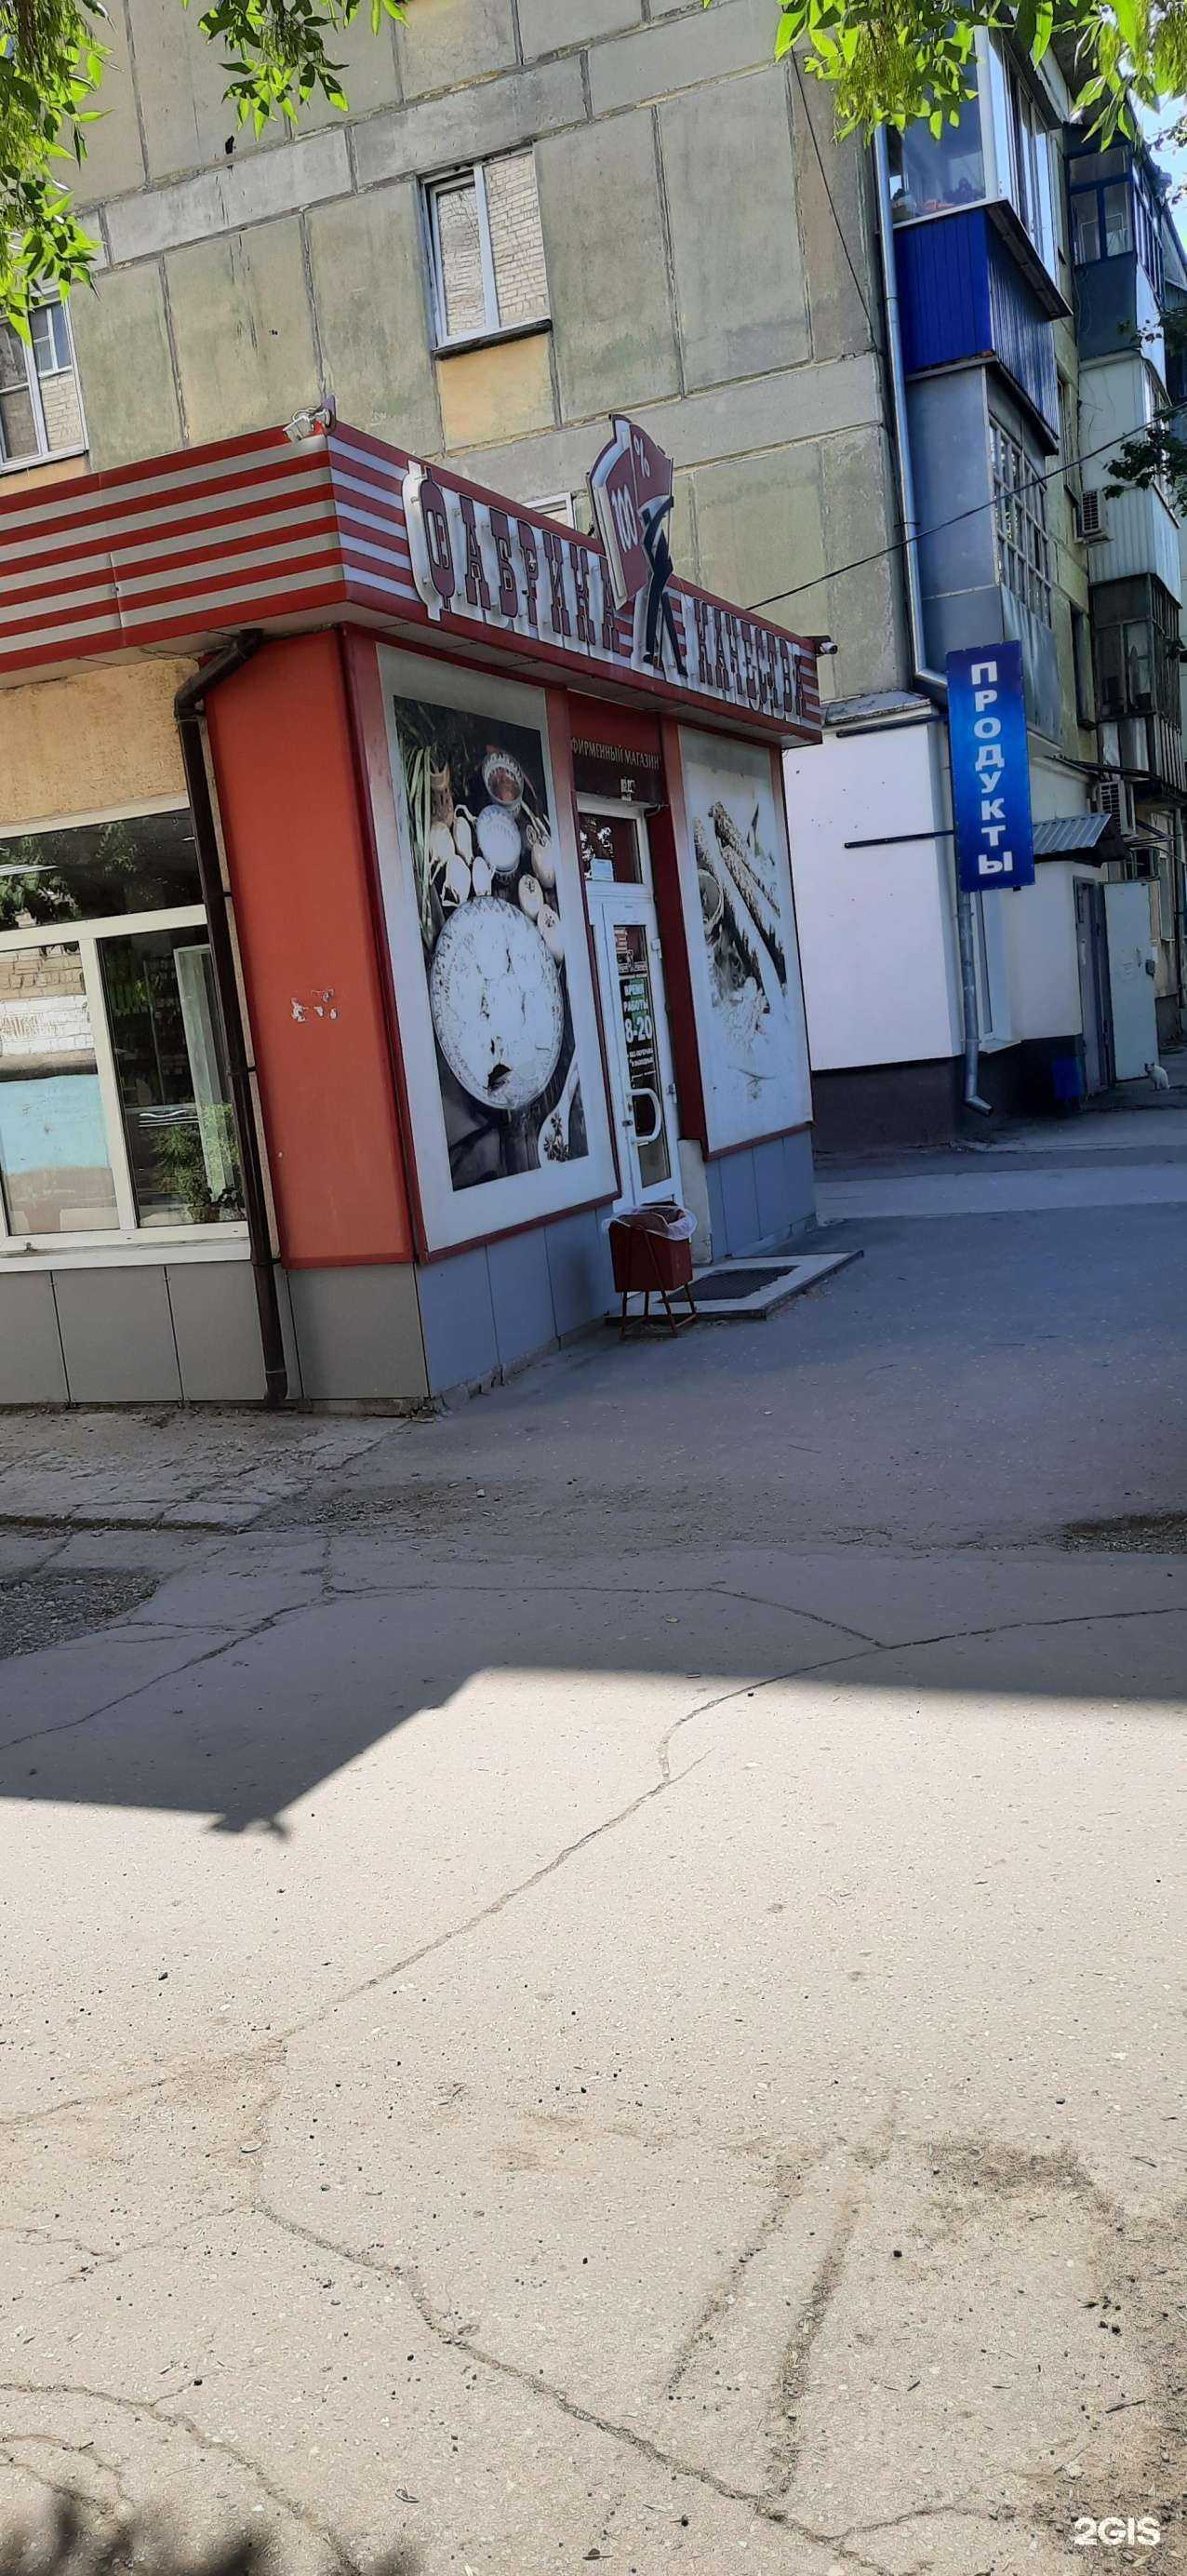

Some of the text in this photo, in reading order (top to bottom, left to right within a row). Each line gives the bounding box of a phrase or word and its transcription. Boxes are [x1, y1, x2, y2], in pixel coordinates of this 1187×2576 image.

[610, 484, 639, 553] 100
[415, 463, 807, 717] ФАБРИКА КАЧЕСТВА
[571, 737, 660, 771] ФИРМЕННЫЙ МАГАЗИН
[970, 661, 1014, 876] ПРОДУКТЫ
[625, 1015, 652, 1042] 8-20
